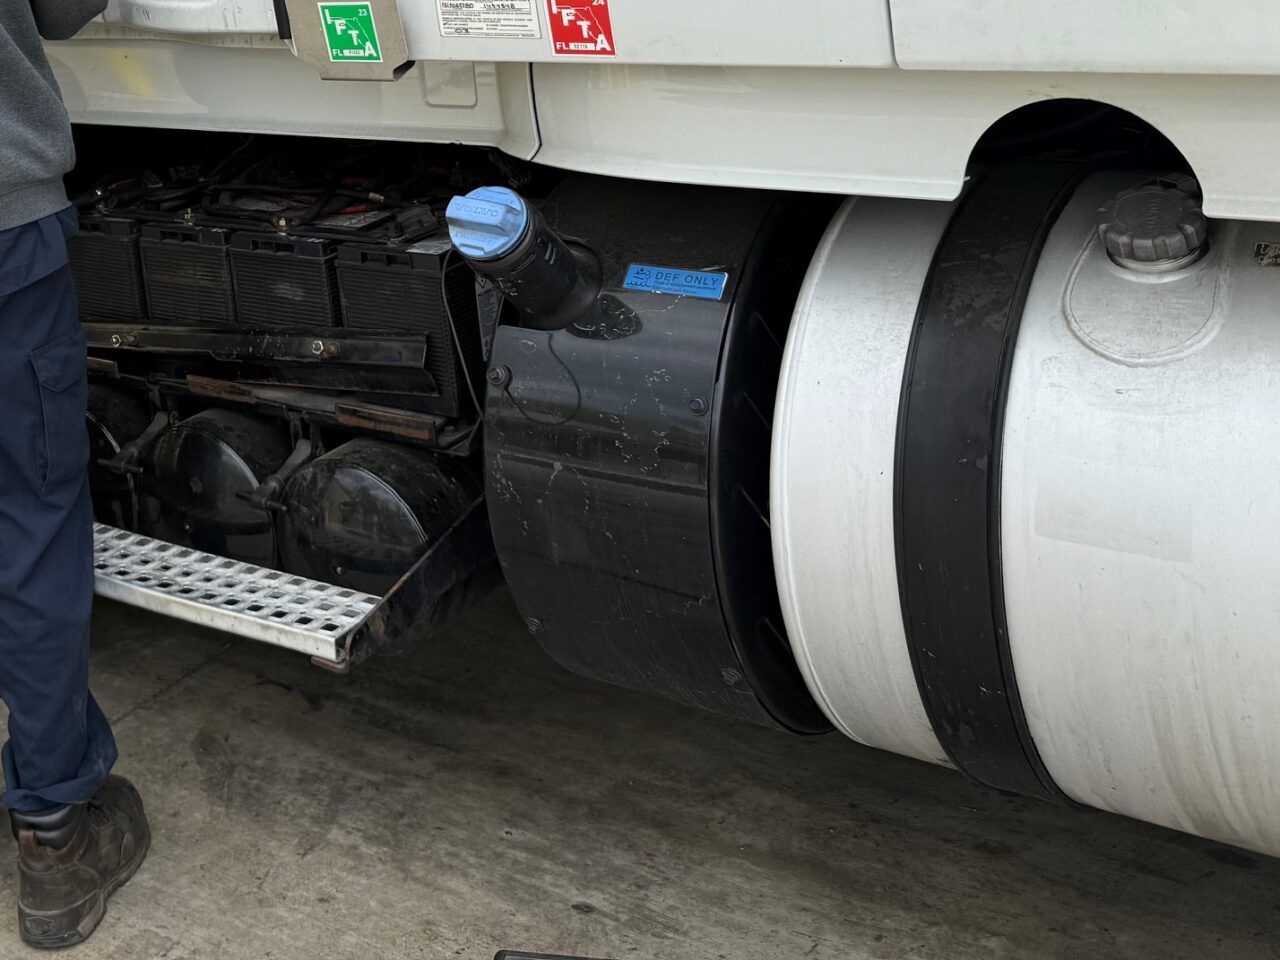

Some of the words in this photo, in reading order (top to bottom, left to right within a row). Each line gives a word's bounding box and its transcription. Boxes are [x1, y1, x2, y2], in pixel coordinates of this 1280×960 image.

[555, 41, 571, 50] FL
[332, 48, 344, 57] FL
[655, 271, 681, 282] DEF
[685, 274, 719, 286] ONLY
